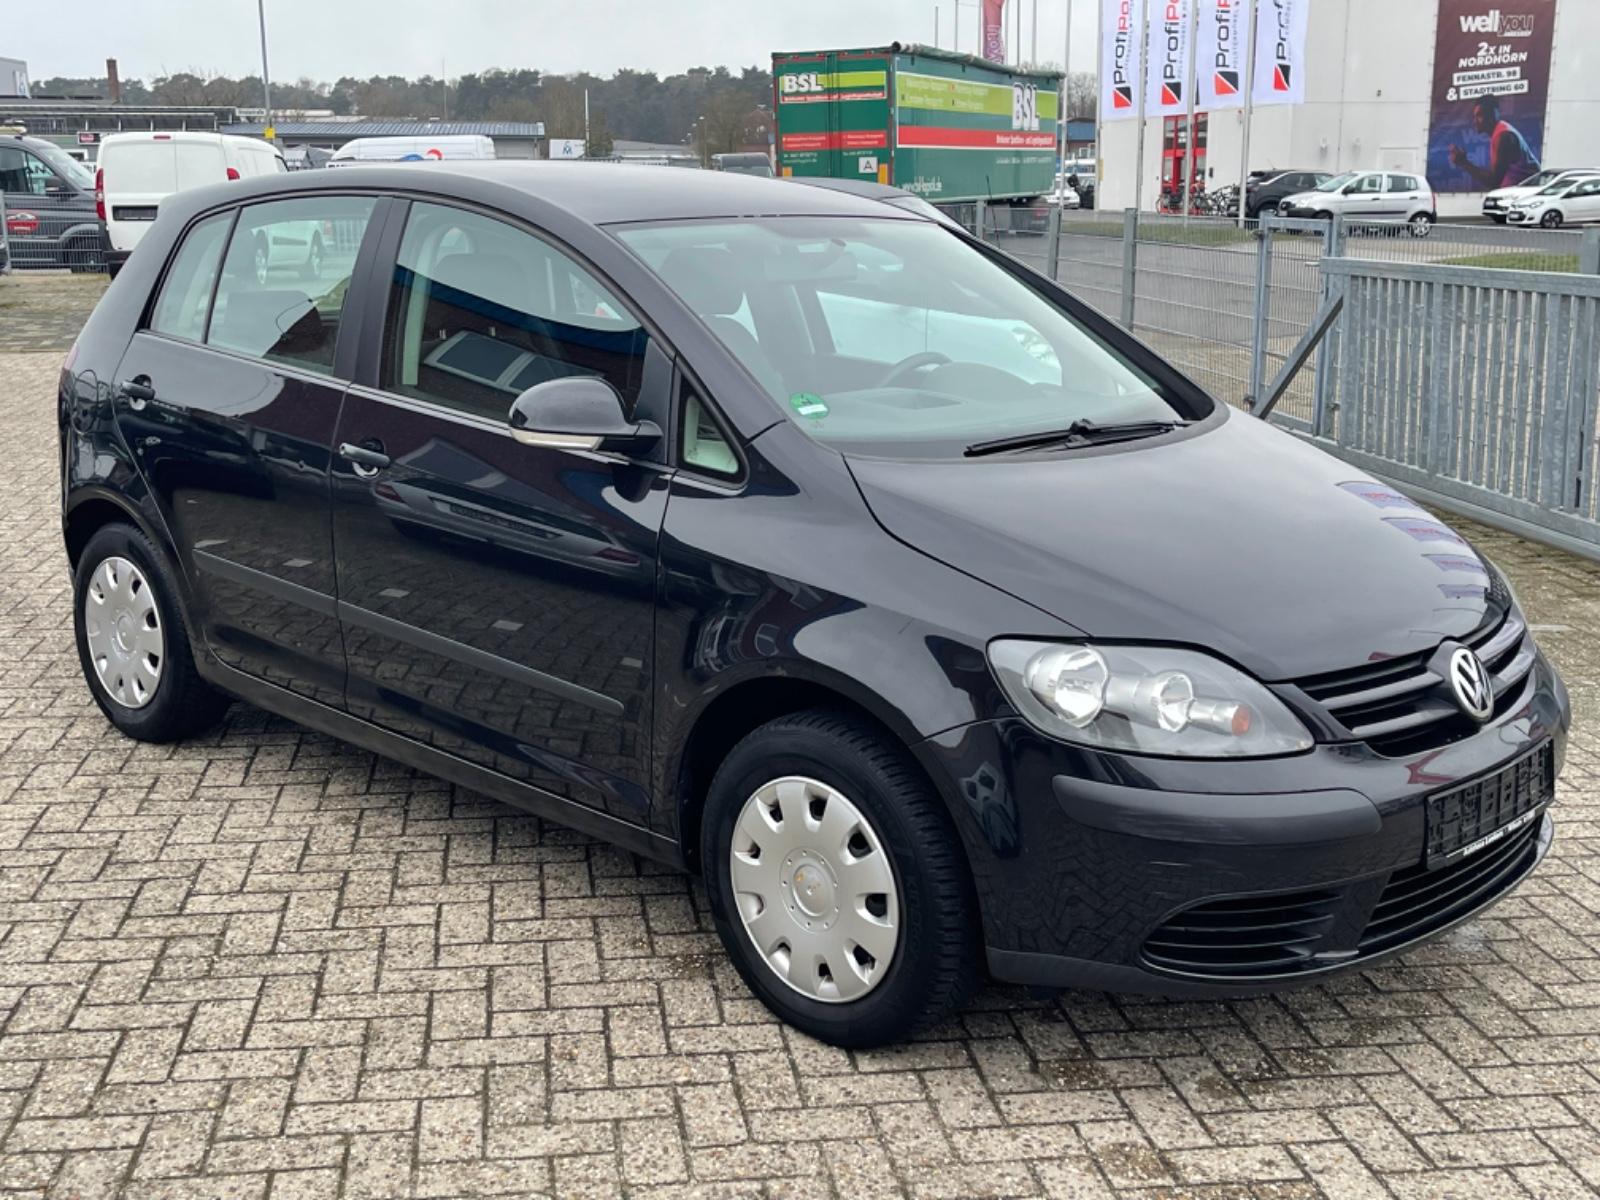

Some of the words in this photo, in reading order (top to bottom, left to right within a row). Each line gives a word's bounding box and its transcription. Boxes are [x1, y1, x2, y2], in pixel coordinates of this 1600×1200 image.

[1460, 9, 1534, 37] wellyou
[1163, 0, 1181, 79] ProfiP
[1477, 42, 1496, 57] 2x
[1498, 44, 1511, 54] IN
[1458, 52, 1528, 68] NORDHORN
[783, 72, 824, 93] BSL
[1446, 87, 1458, 101] &
[1012, 82, 1040, 131] BSL
[863, 160, 874, 172] A
